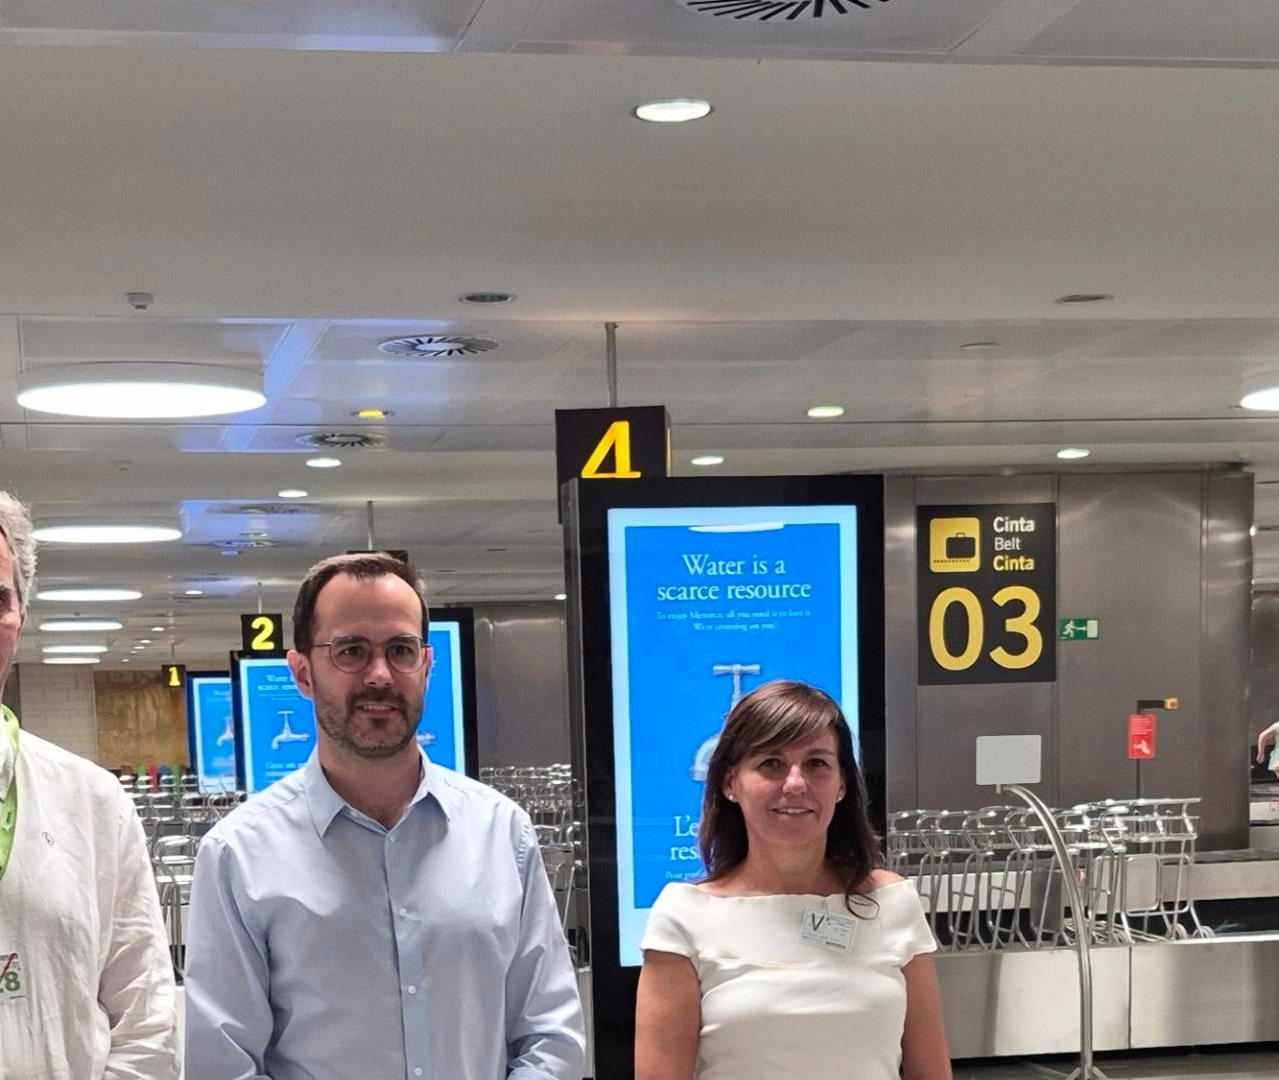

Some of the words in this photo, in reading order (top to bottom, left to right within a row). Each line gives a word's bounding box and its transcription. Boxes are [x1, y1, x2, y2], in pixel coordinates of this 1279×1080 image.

[581, 420, 642, 479] 4
[993, 516, 1036, 533] Cinta
[994, 537, 1021, 551] Belt
[681, 553, 746, 576] Water
[752, 554, 768, 575] is
[774, 559, 786, 575] a
[993, 555, 1035, 572] Cinta
[657, 585, 720, 601] scarce
[727, 583, 812, 600] resource
[251, 616, 275, 650] 2
[929, 585, 1043, 671] 03
[169, 667, 181, 687] 1
[673, 815, 700, 837] L'e
